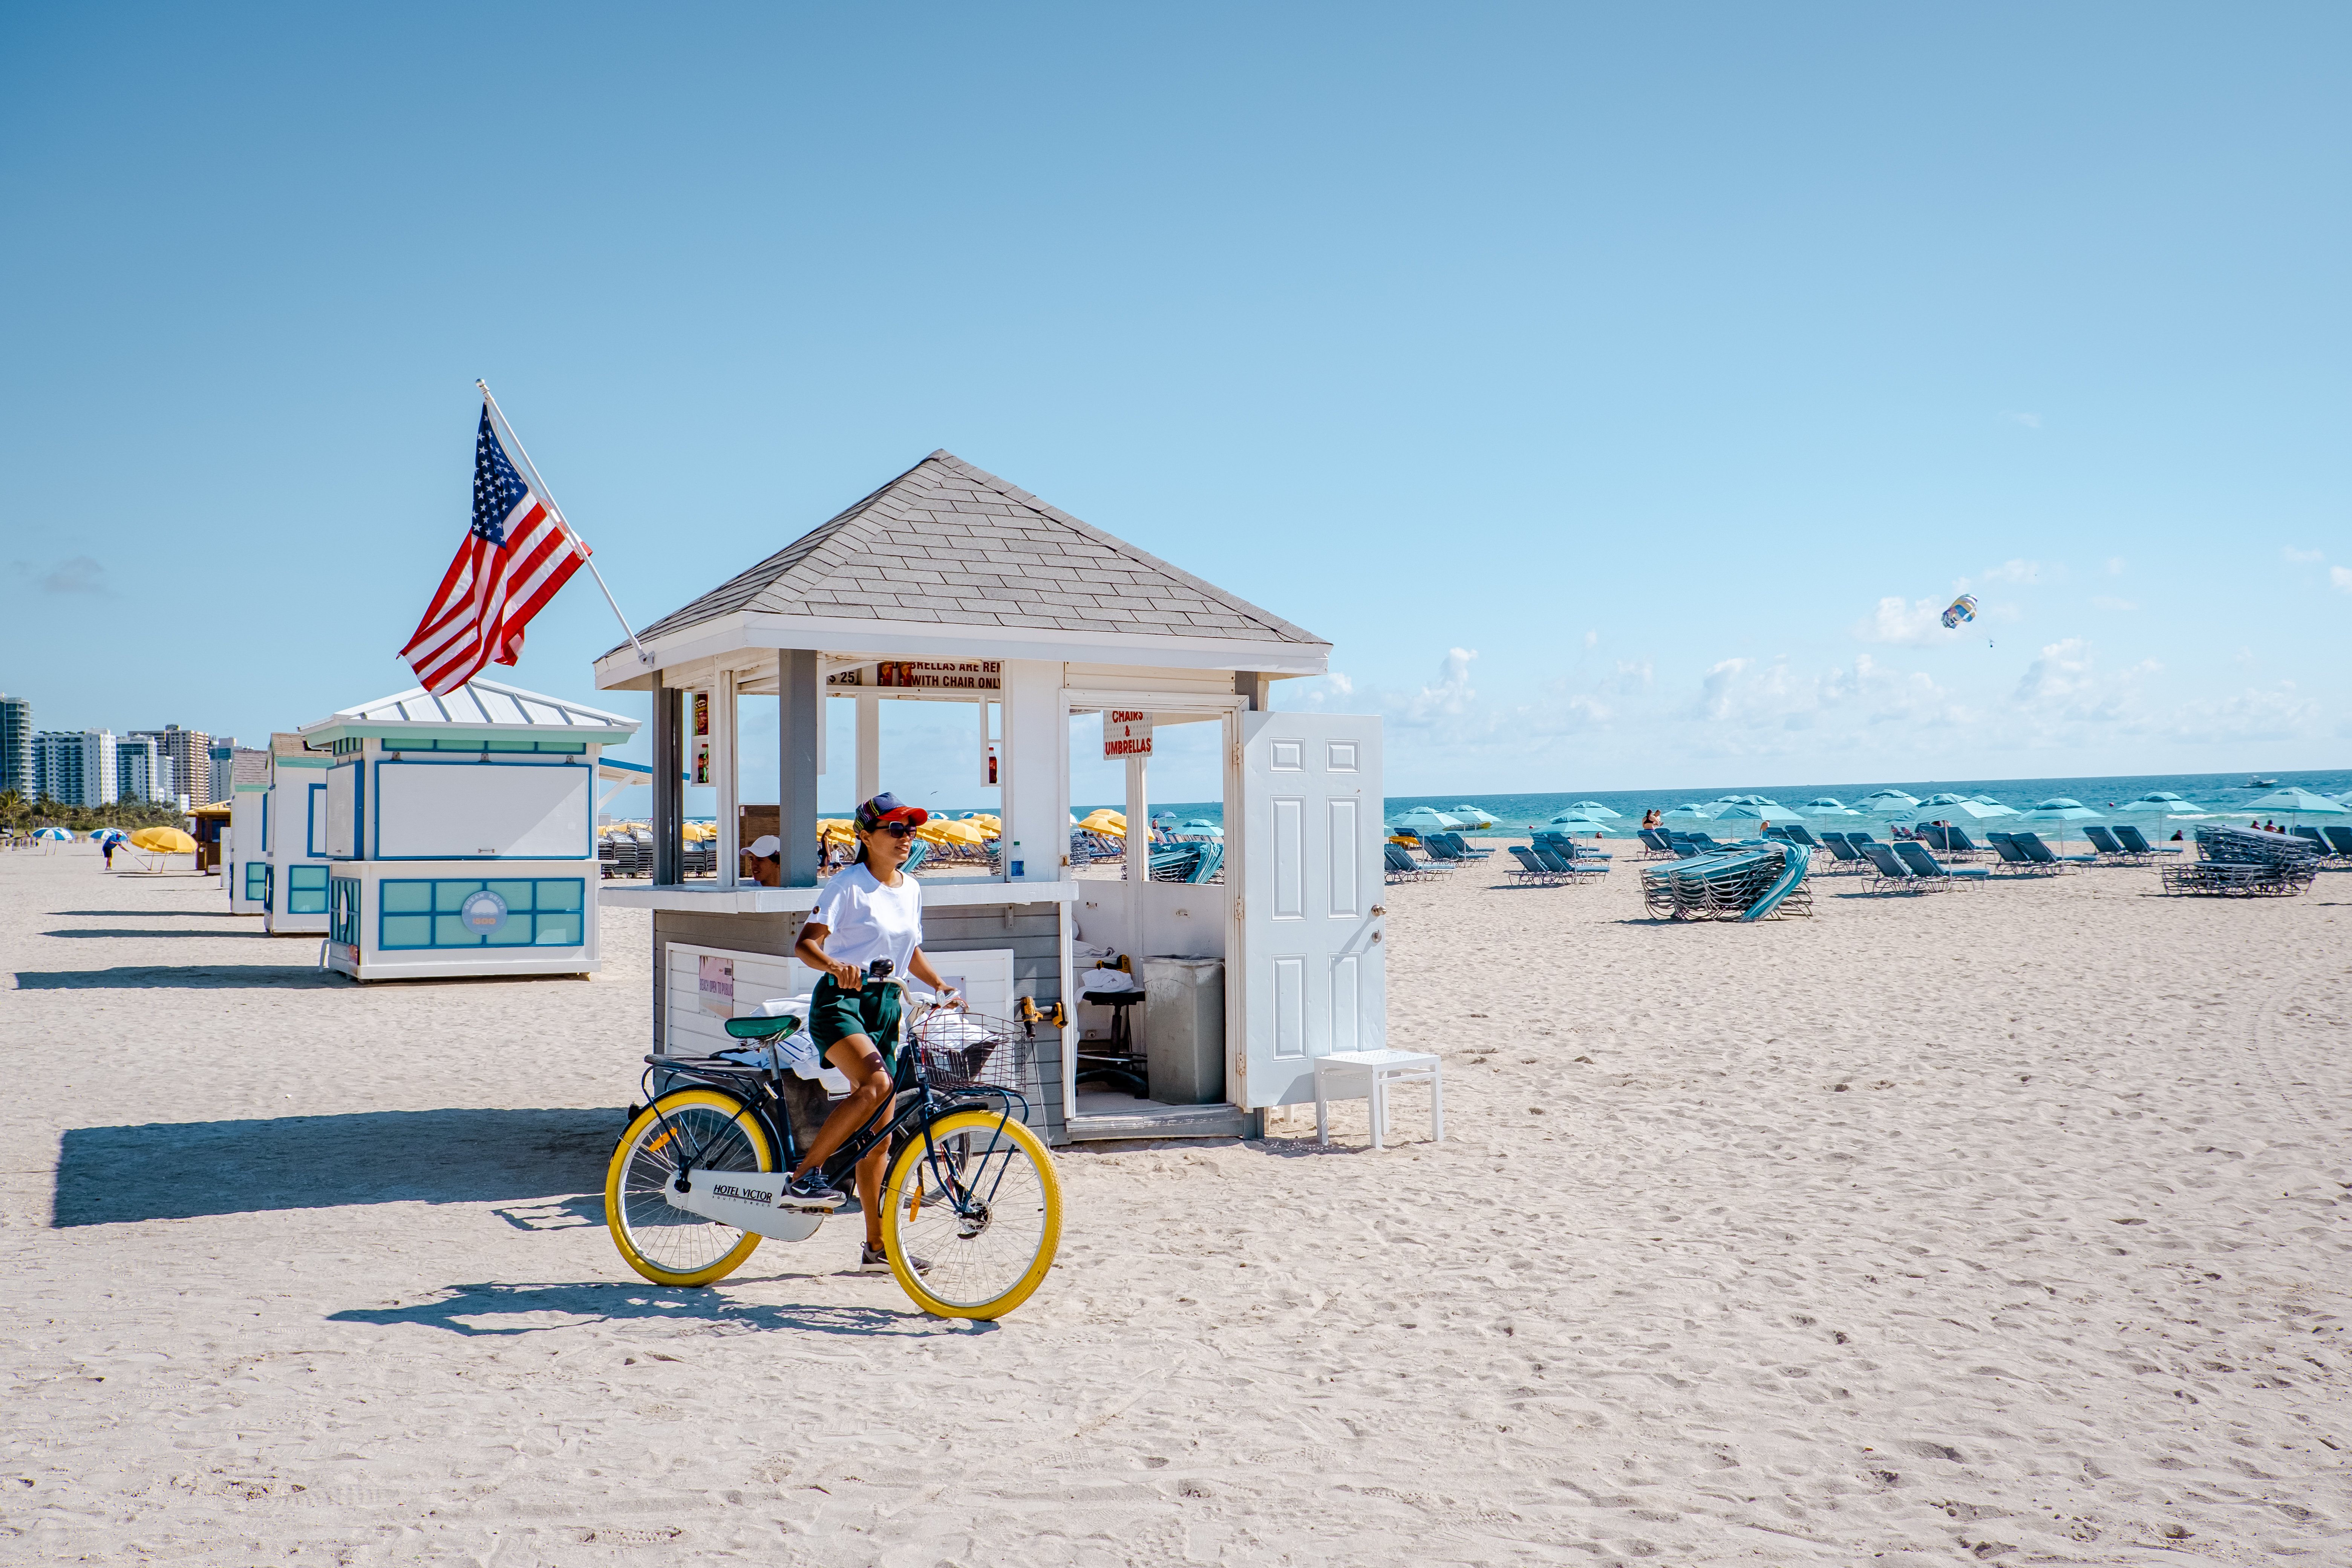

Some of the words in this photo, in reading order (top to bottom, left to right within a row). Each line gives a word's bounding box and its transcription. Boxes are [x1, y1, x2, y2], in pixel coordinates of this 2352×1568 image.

[959, 663, 979, 672] ARE
[840, 671, 854, 683] 25
[911, 675, 939, 686] WITH
[943, 675, 975, 688] CHAIR
[1112, 710, 1143, 723] CHAIRS
[1125, 725, 1130, 737] &
[1105, 737, 1151, 755] UMBRELLAS
[464, 893, 484, 910] OCEAN
[489, 894, 505, 910] DRIVE
[700, 978, 709, 991] BEACH
[717, 982, 721, 994] TO
[713, 1184, 740, 1196] HOTEL
[743, 1188, 772, 1201] VICTOR
[744, 1199, 770, 1208] beach
